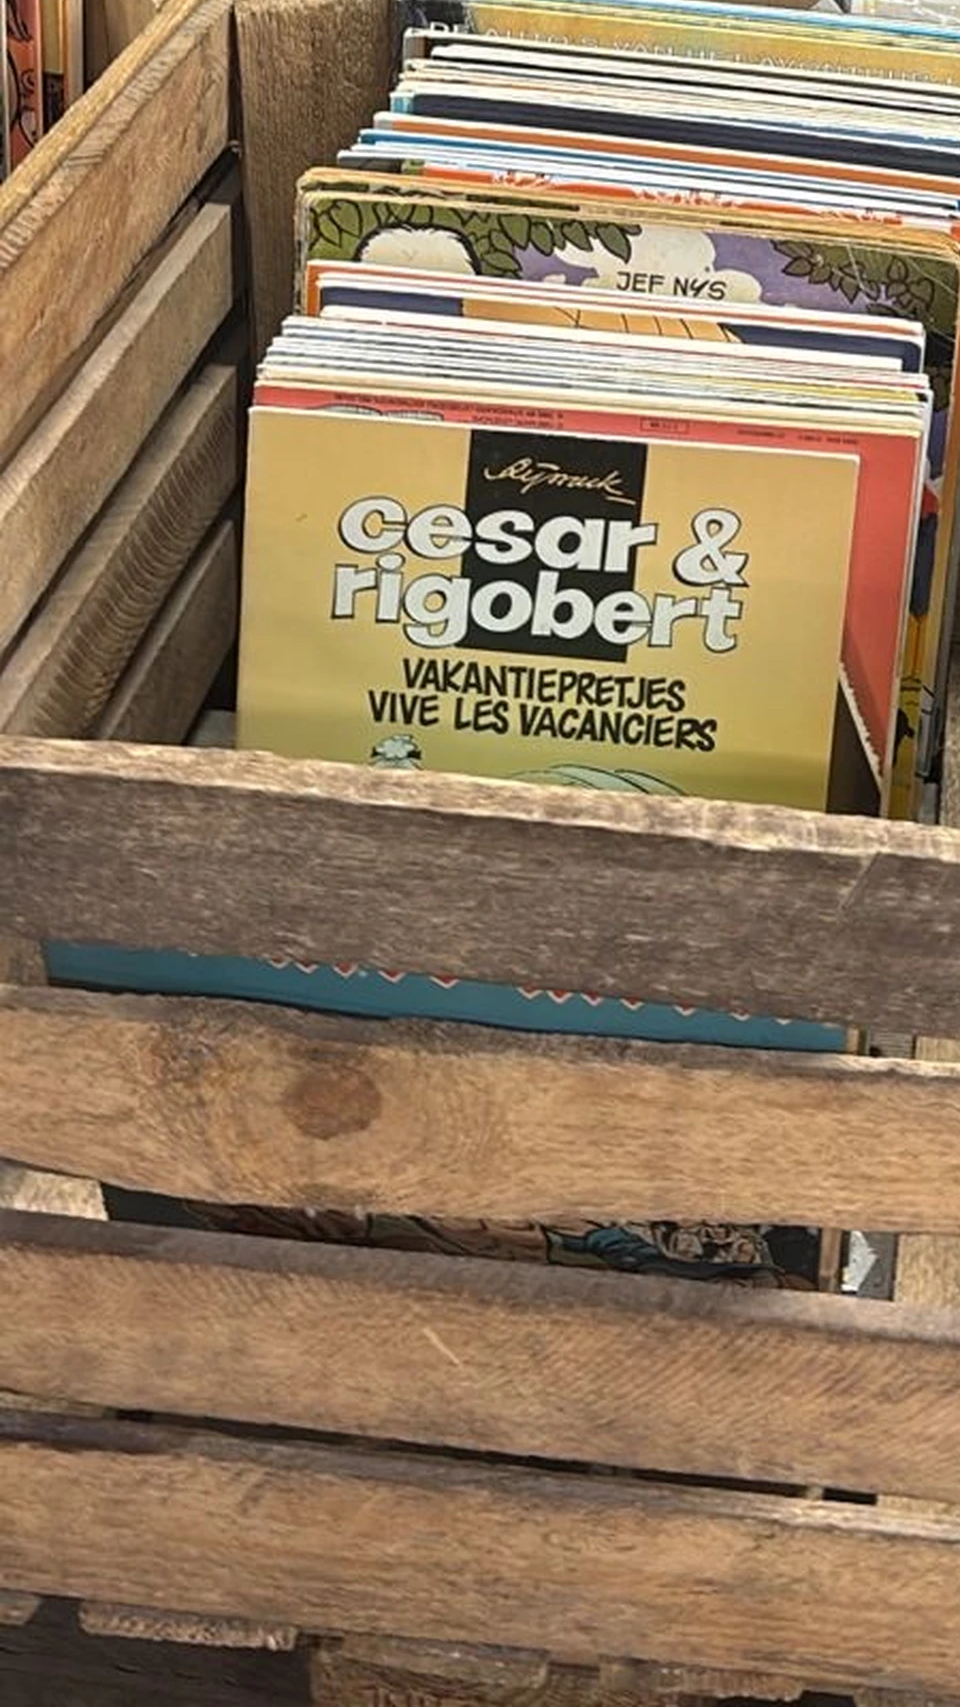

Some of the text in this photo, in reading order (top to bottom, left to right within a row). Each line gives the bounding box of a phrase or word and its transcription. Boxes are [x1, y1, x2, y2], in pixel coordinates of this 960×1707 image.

[616, 272, 728, 300] JEF NYS
[338, 495, 749, 590] cesar &
[331, 551, 743, 653] rigobert
[402, 657, 686, 713] VAKANTIEPRETJES
[368, 689, 718, 753] VIVE LES VACANCIERS
